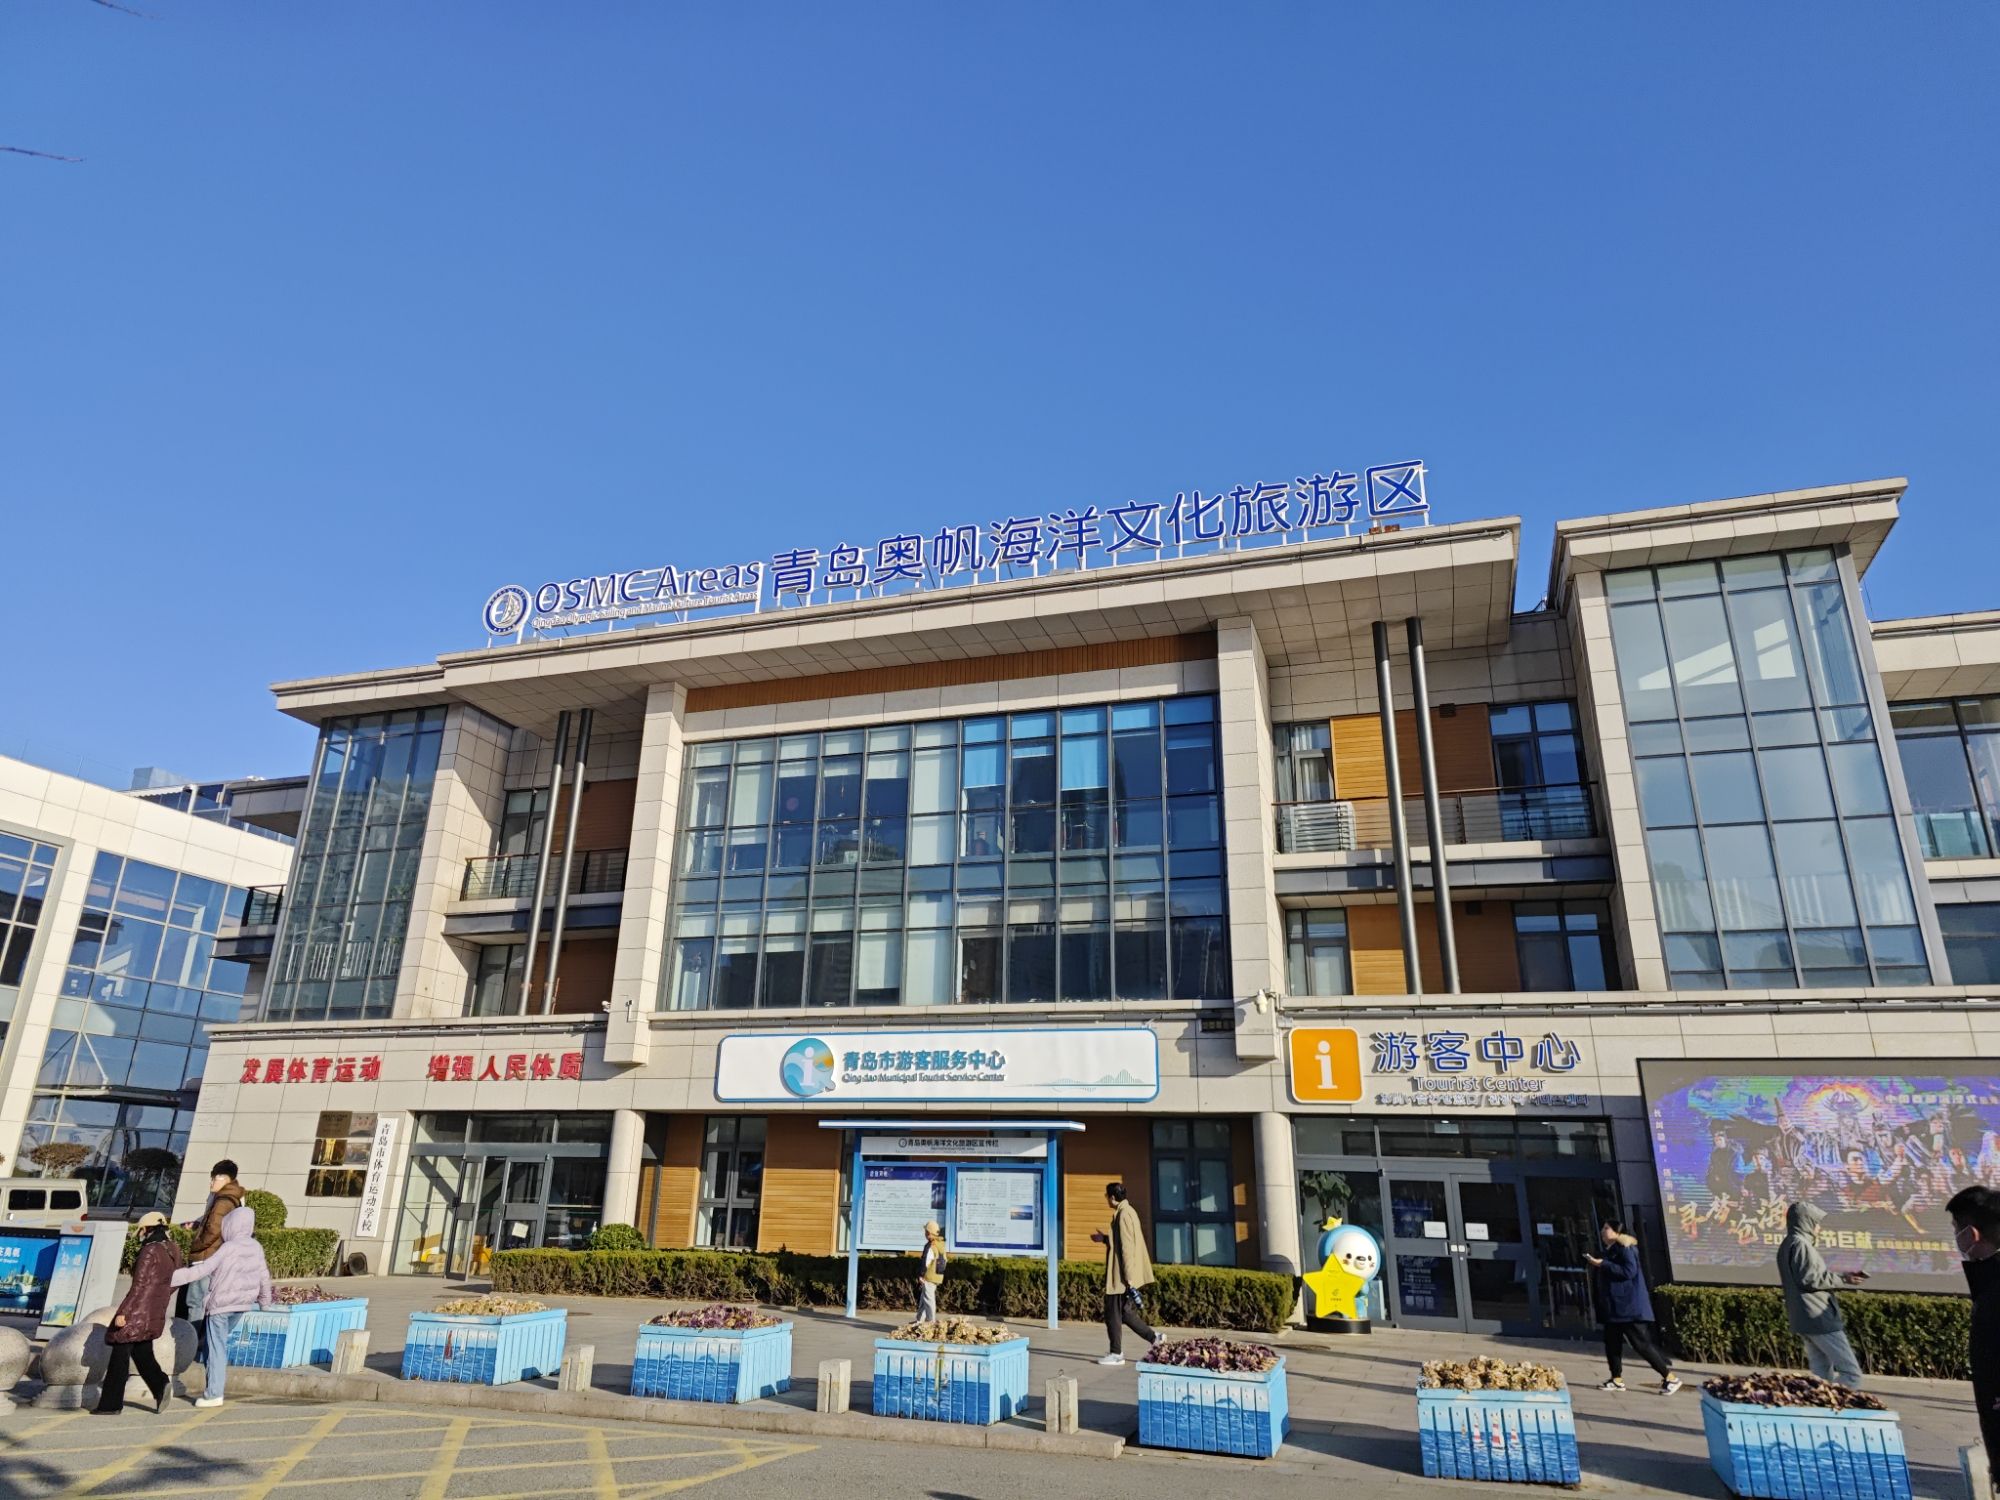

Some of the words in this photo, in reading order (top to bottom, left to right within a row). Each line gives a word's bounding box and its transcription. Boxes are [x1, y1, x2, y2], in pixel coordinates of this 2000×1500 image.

[770, 459, 1429, 598] 青岛奥帆海洋文化旅游区
[535, 569, 645, 613] OSMC
[654, 561, 760, 598] Areas
[734, 591, 758, 602] Areas
[842, 1050, 1006, 1071] 青岛市游客服务中心
[1375, 1030, 1582, 1074] 游客中心
[239, 1056, 383, 1084] 发展体育运动
[425, 1052, 584, 1081] 增强人民体质
[878, 1072, 917, 1084] Municipal
[918, 1072, 945, 1082] Tourist
[945, 1072, 976, 1082] Service
[977, 1072, 1005, 1082] Center
[1414, 1075, 1480, 1091] Tourist
[1483, 1075, 1546, 1091] Center
[361, 1123, 391, 1232] 青岛市体育运动学校
